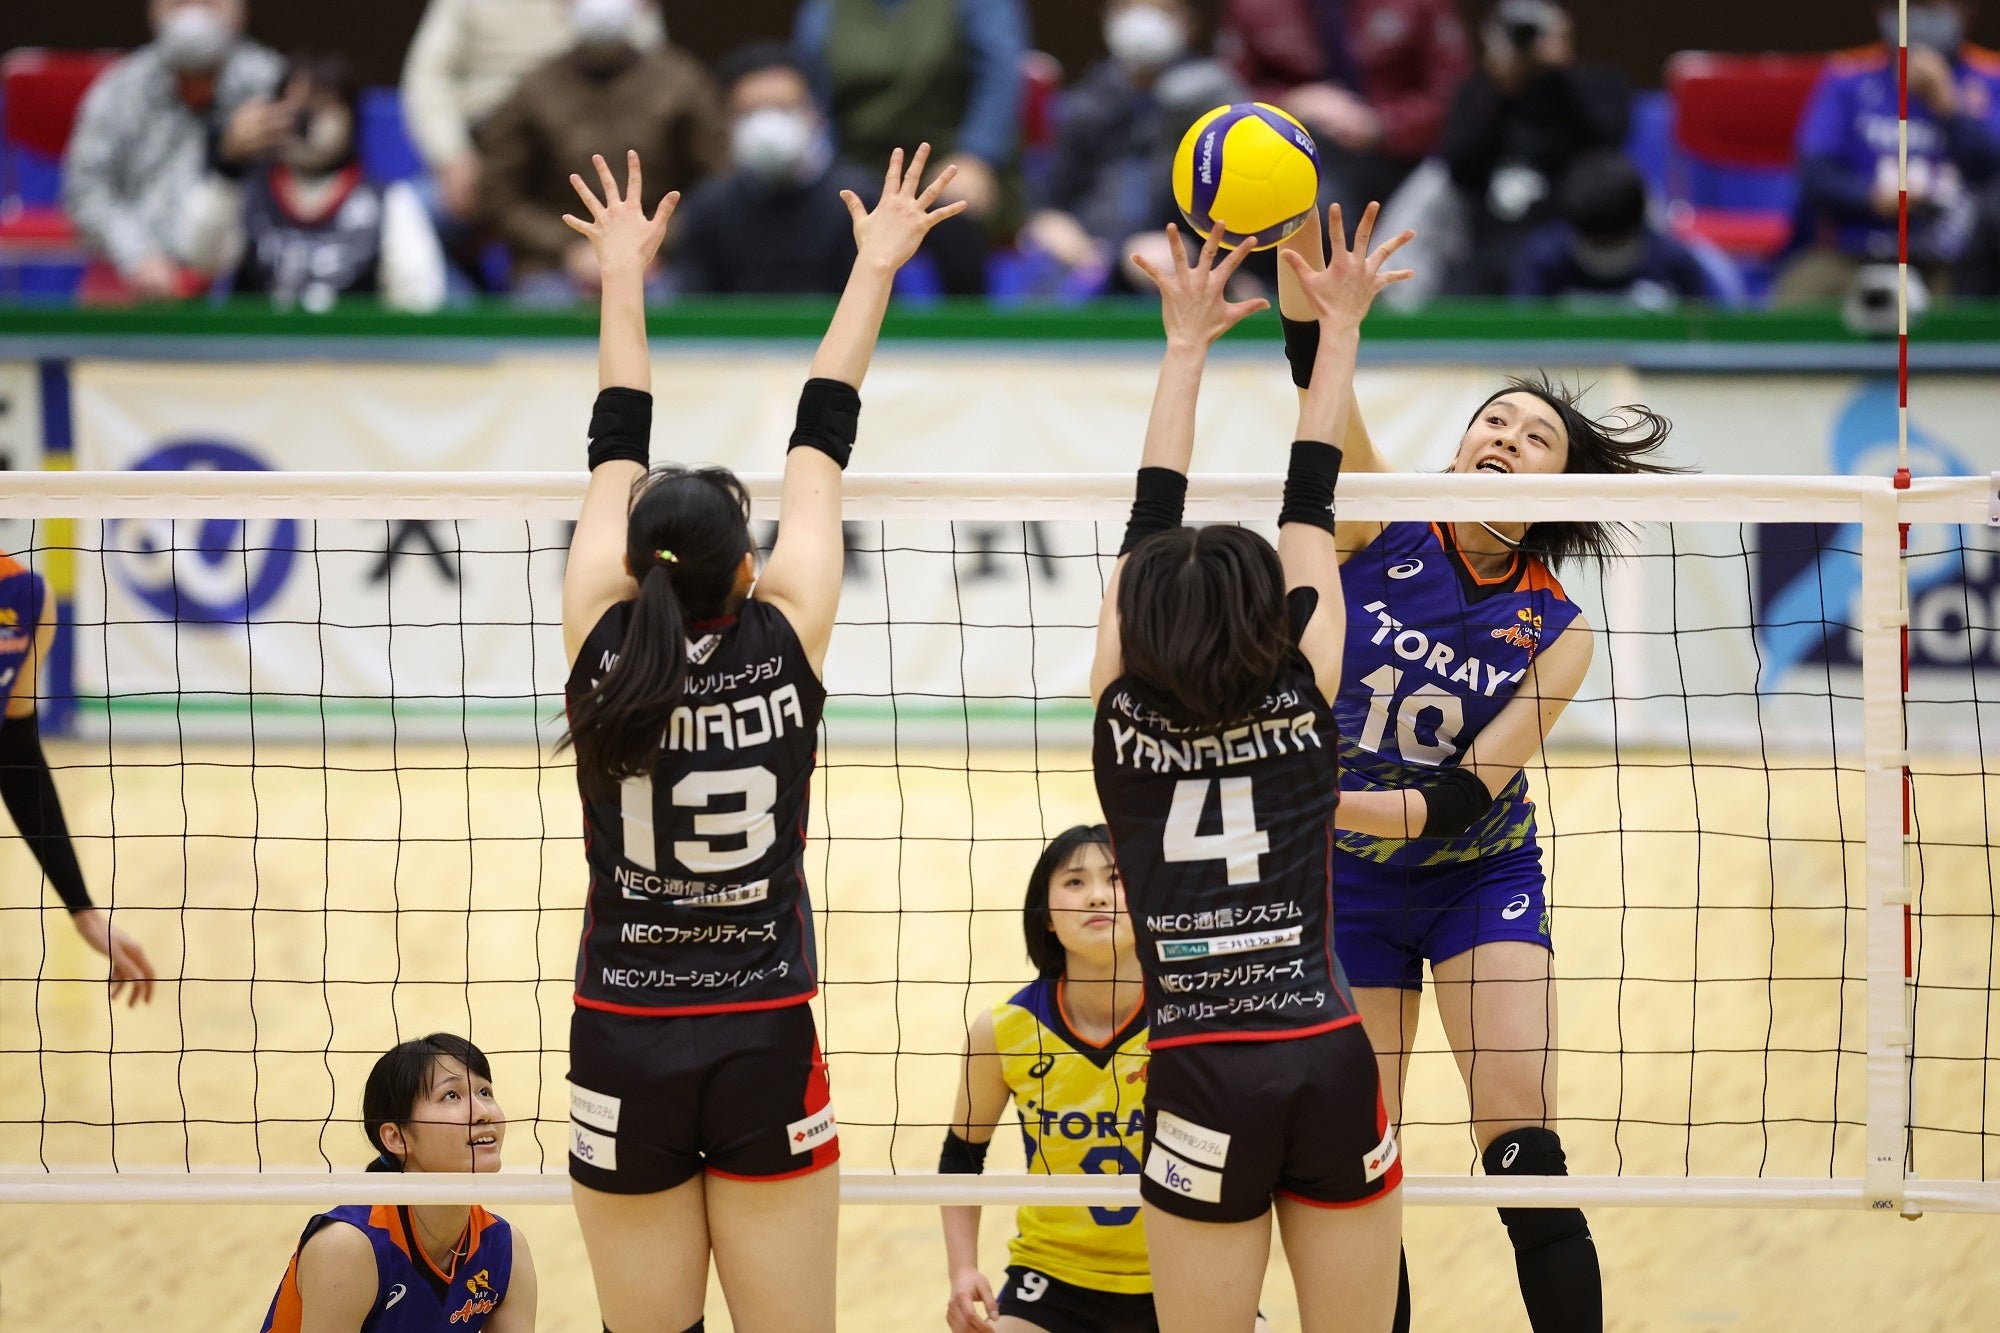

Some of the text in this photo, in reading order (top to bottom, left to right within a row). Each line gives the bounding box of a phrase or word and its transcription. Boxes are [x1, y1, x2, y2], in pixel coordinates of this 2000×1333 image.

[1370, 610, 1512, 697] TORAY
[591, 678, 804, 752] MADA
[1358, 664, 1465, 767] 10
[1108, 711, 1322, 774] YANAGITA
[621, 765, 777, 873] 13
[1163, 776, 1270, 886] 4
[621, 921, 777, 944] NECファシリティーズ
[1147, 900, 1303, 933] NEC通信システム
[602, 960, 789, 988] NECソリューションイノベータ
[1158, 958, 1305, 994] NECファシリティーズ
[1037, 1108, 1146, 1140] TORA
[574, 1127, 595, 1161] Yec
[1165, 1159, 1192, 1193] Yec
[1016, 1271, 1049, 1302] 9
